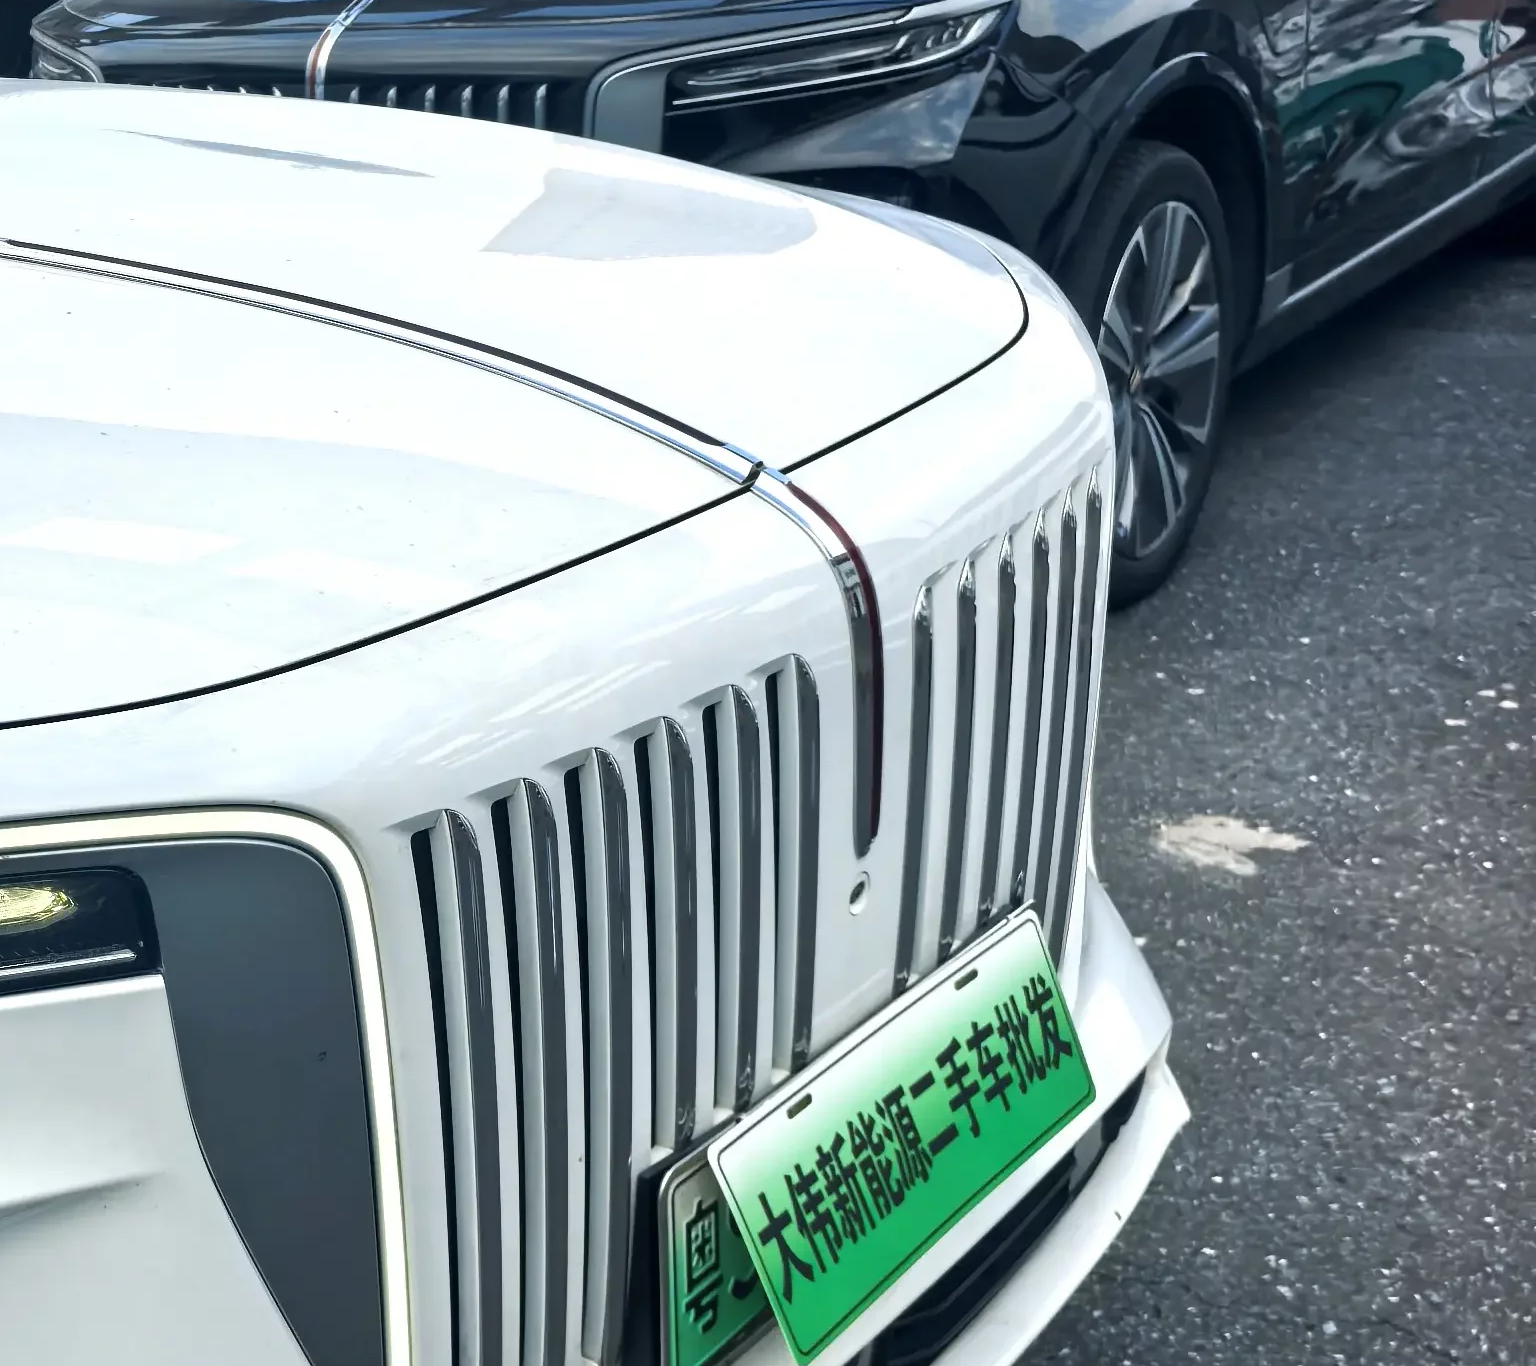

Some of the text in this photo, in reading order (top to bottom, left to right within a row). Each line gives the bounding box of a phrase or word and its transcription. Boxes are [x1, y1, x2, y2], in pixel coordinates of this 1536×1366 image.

[757, 973, 1073, 1304] 大伟新能源二手车批发
